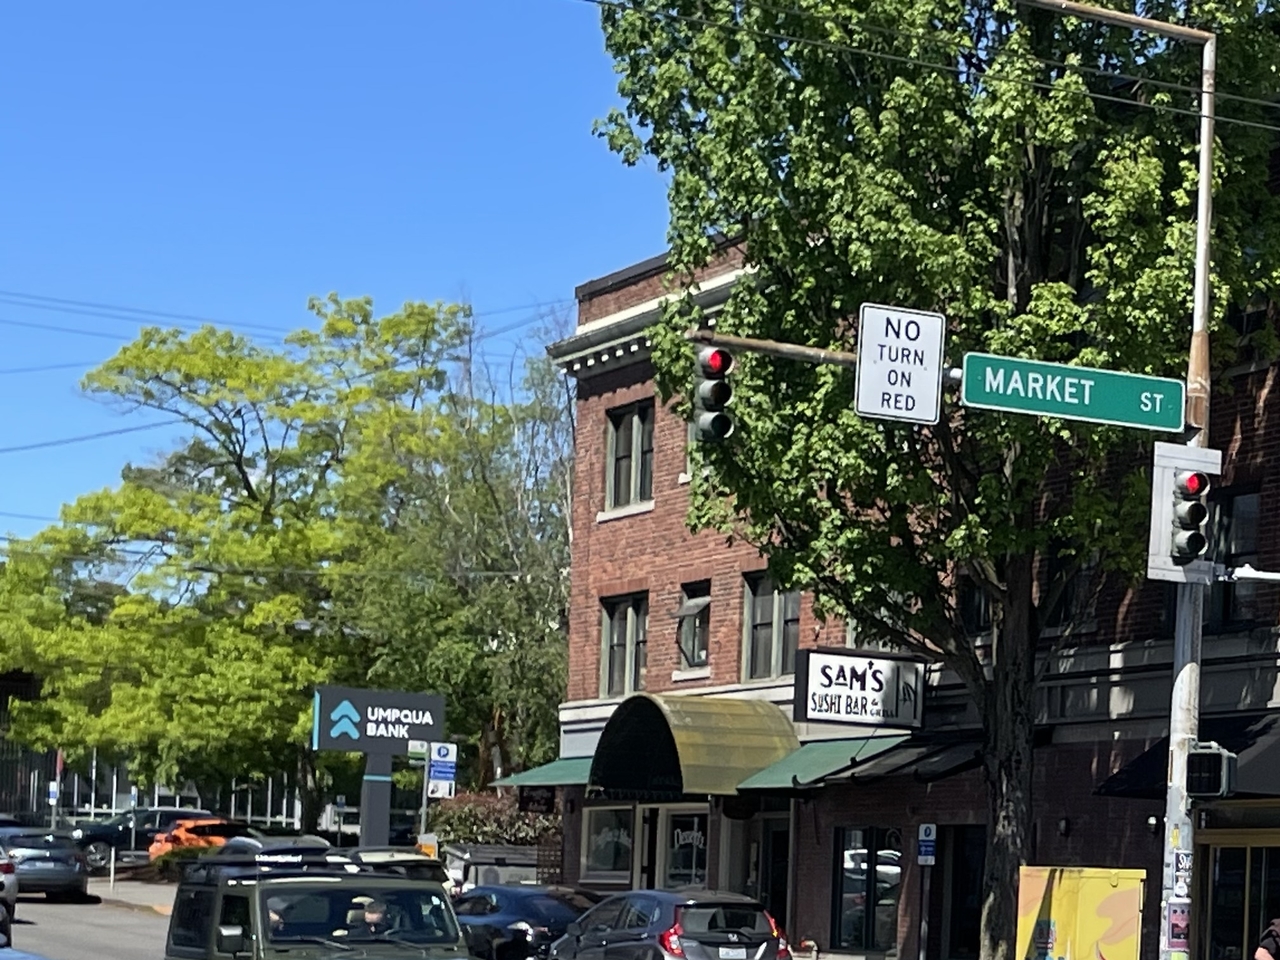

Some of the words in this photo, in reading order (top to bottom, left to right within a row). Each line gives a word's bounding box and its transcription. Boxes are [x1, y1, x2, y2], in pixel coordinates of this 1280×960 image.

[885, 317, 920, 341] NO
[878, 344, 925, 366] TURN
[887, 370, 912, 388] ON
[984, 366, 1095, 406] MARKET
[1140, 391, 1164, 414] ST
[881, 392, 916, 412] RED
[820, 660, 884, 693] SAM'S
[811, 692, 842, 715] SUSHI
[845, 694, 868, 716] BAR
[367, 706, 434, 726] UMPQUA
[366, 722, 410, 739] BANK
